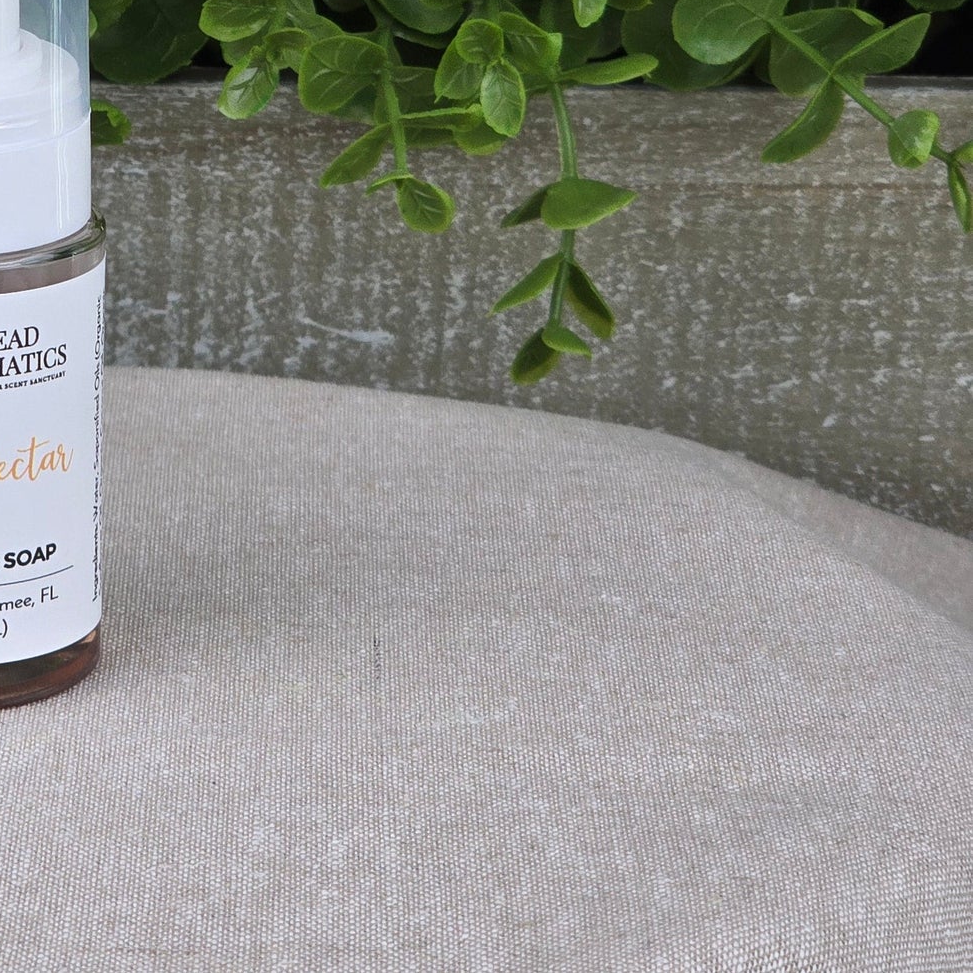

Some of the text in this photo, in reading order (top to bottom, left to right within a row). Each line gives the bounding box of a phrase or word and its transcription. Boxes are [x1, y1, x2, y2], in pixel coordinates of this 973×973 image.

[5, 380, 28, 390] SCENT
[3, 543, 57, 569] SOAP
[41, 585, 59, 602] FL
